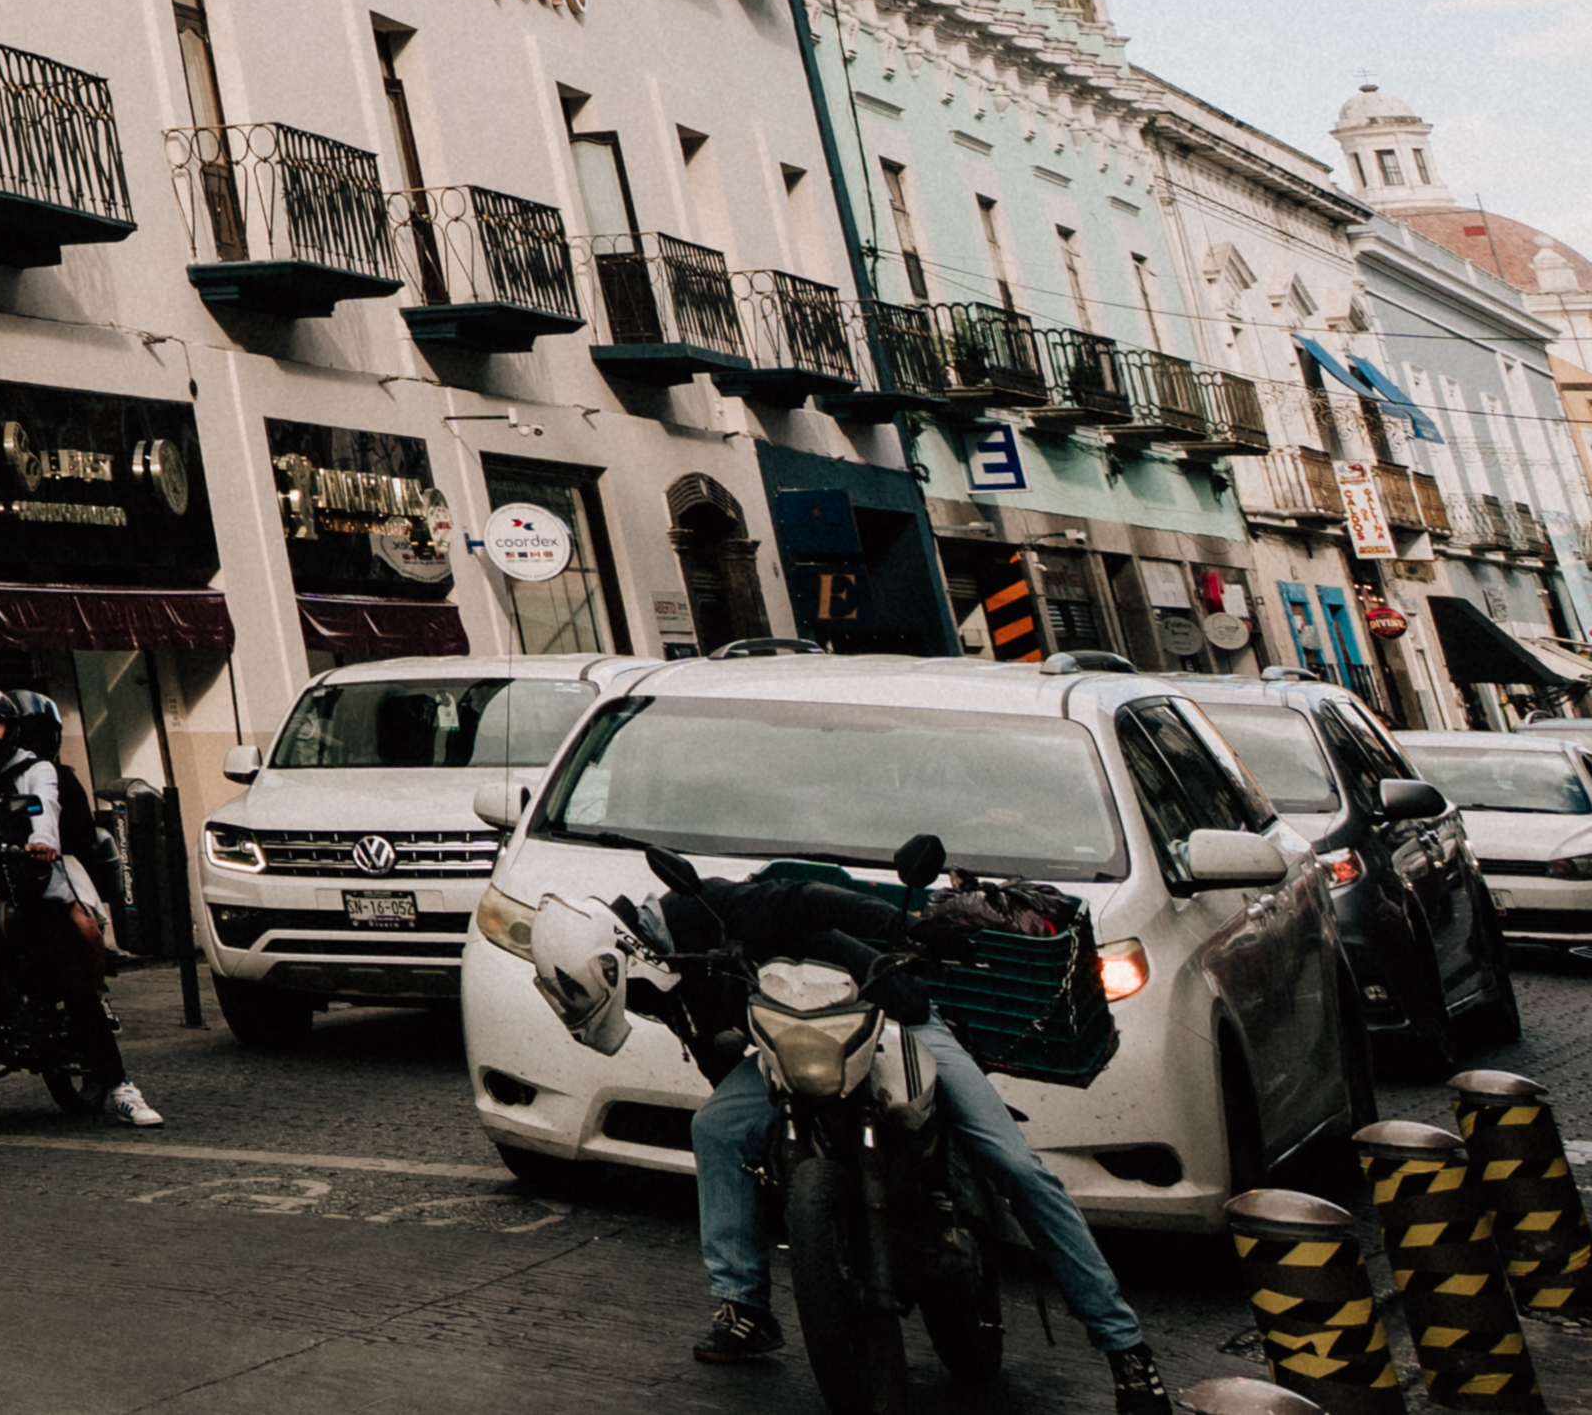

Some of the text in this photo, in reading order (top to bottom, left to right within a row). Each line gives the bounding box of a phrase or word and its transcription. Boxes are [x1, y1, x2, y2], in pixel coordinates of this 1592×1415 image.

[495, 534, 558, 548] coordex
[817, 574, 858, 619] E
[1370, 619, 1407, 629] DIVINE
[346, 899, 415, 916] SN-16-052
